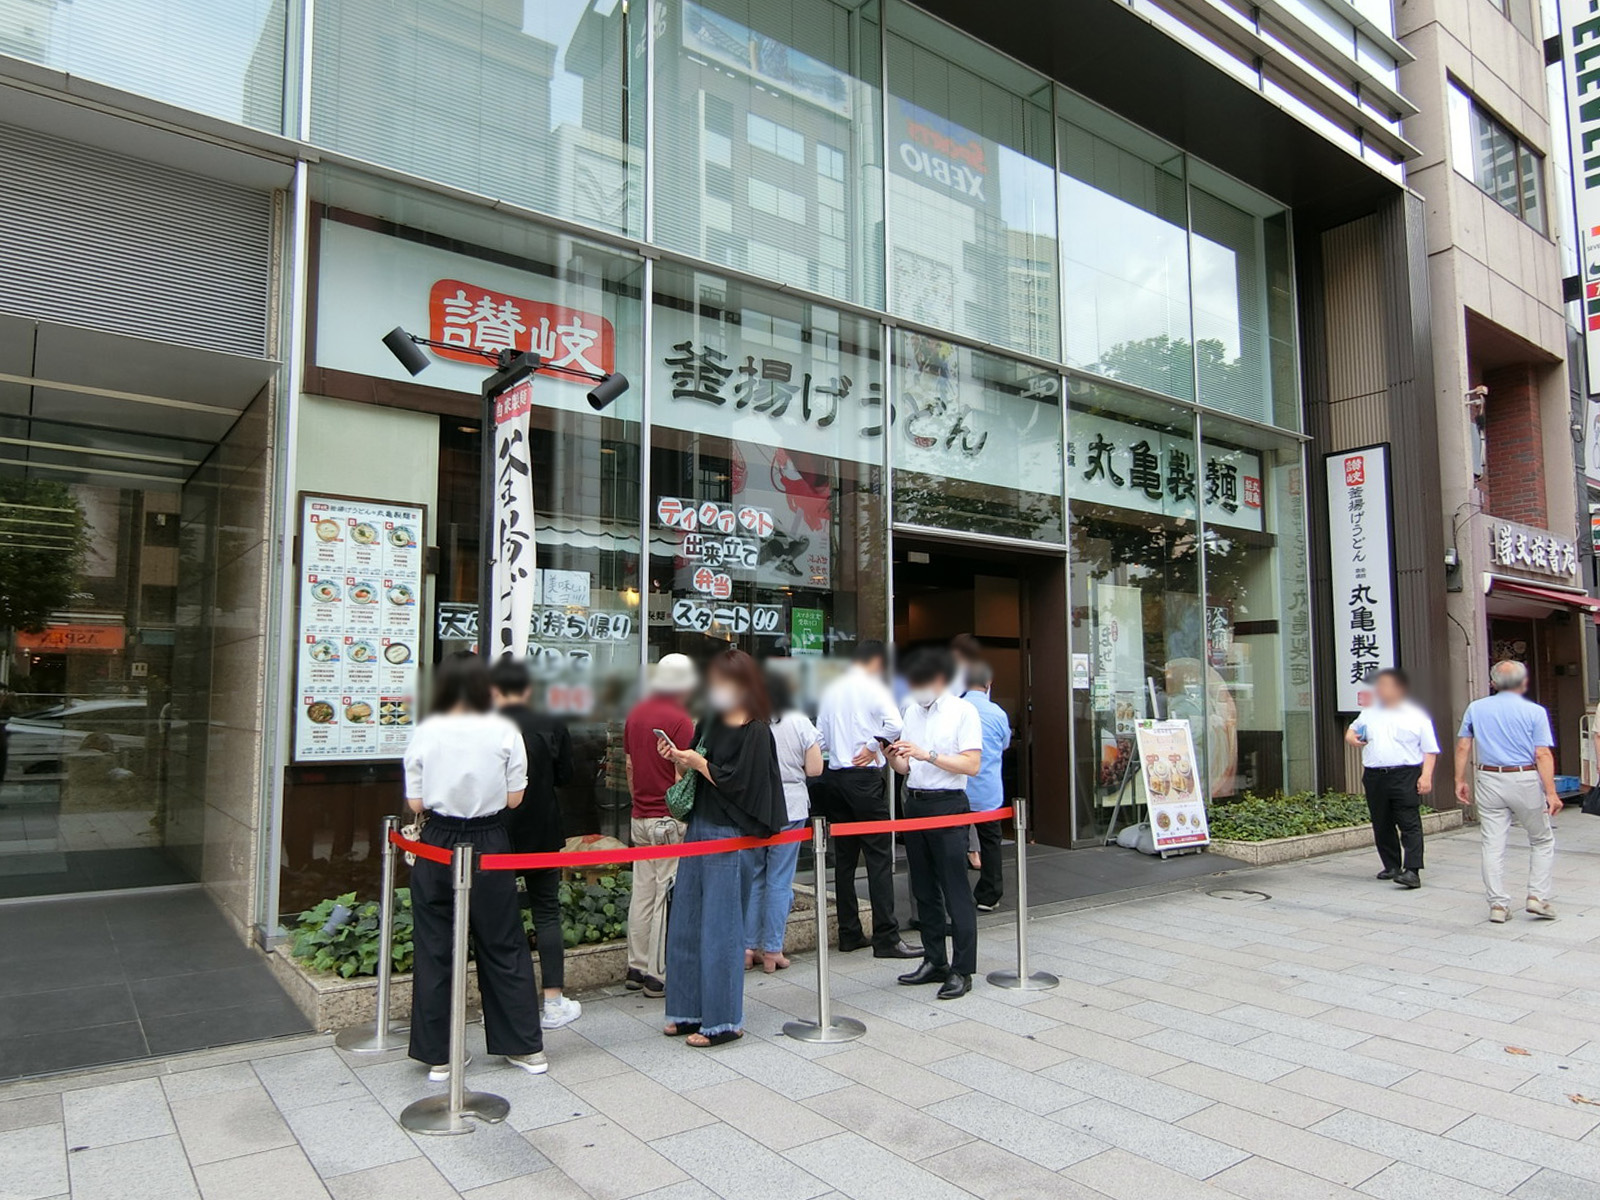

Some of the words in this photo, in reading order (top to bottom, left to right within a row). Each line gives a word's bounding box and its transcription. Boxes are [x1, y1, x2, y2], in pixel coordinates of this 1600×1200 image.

[443, 289, 605, 376] 讃岐
[1083, 433, 1240, 515] 丸亀製麺
[685, 535, 758, 567] 出来立て
[1347, 487, 1367, 563] 釜揚げうどん
[695, 568, 730, 597] 弁当
[1349, 583, 1380, 684] 丸亀製麺
